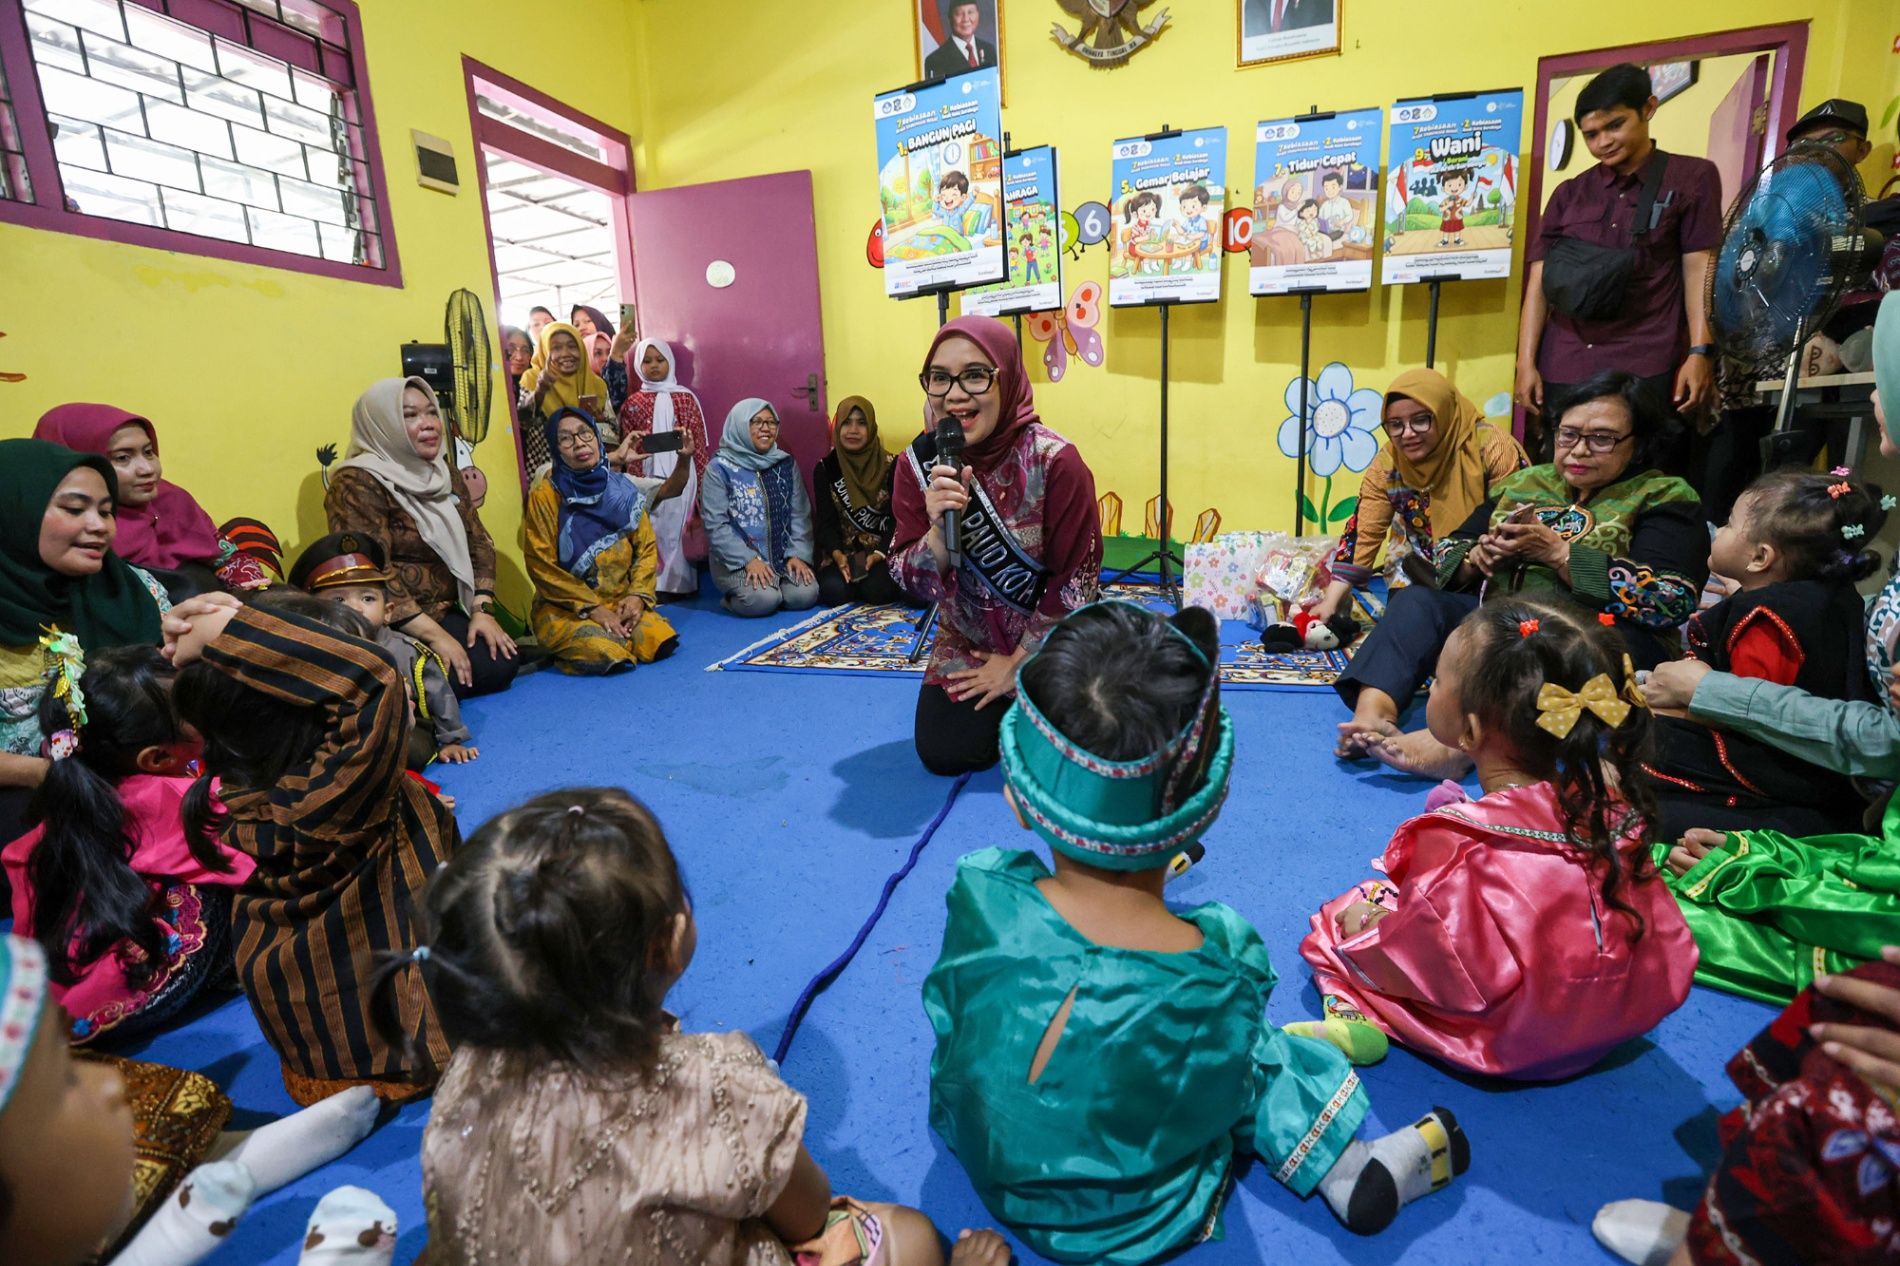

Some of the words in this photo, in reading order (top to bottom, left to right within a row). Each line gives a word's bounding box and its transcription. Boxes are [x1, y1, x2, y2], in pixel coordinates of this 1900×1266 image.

[907, 126, 951, 152] BANGUN
[951, 118, 977, 140] PAGI
[1430, 130, 1482, 158] Wani
[1288, 158, 1321, 175] Tidur
[1321, 151, 1357, 168] Cepat
[1135, 175, 1170, 191] Gemar
[1171, 167, 1211, 185] Belajar
[1005, 185, 1038, 203] AHRAGA
[1084, 209, 1102, 238] 6
[1228, 215, 1254, 246] 10
[961, 511, 1008, 569] PAUD
[990, 562, 1039, 605] KOA
